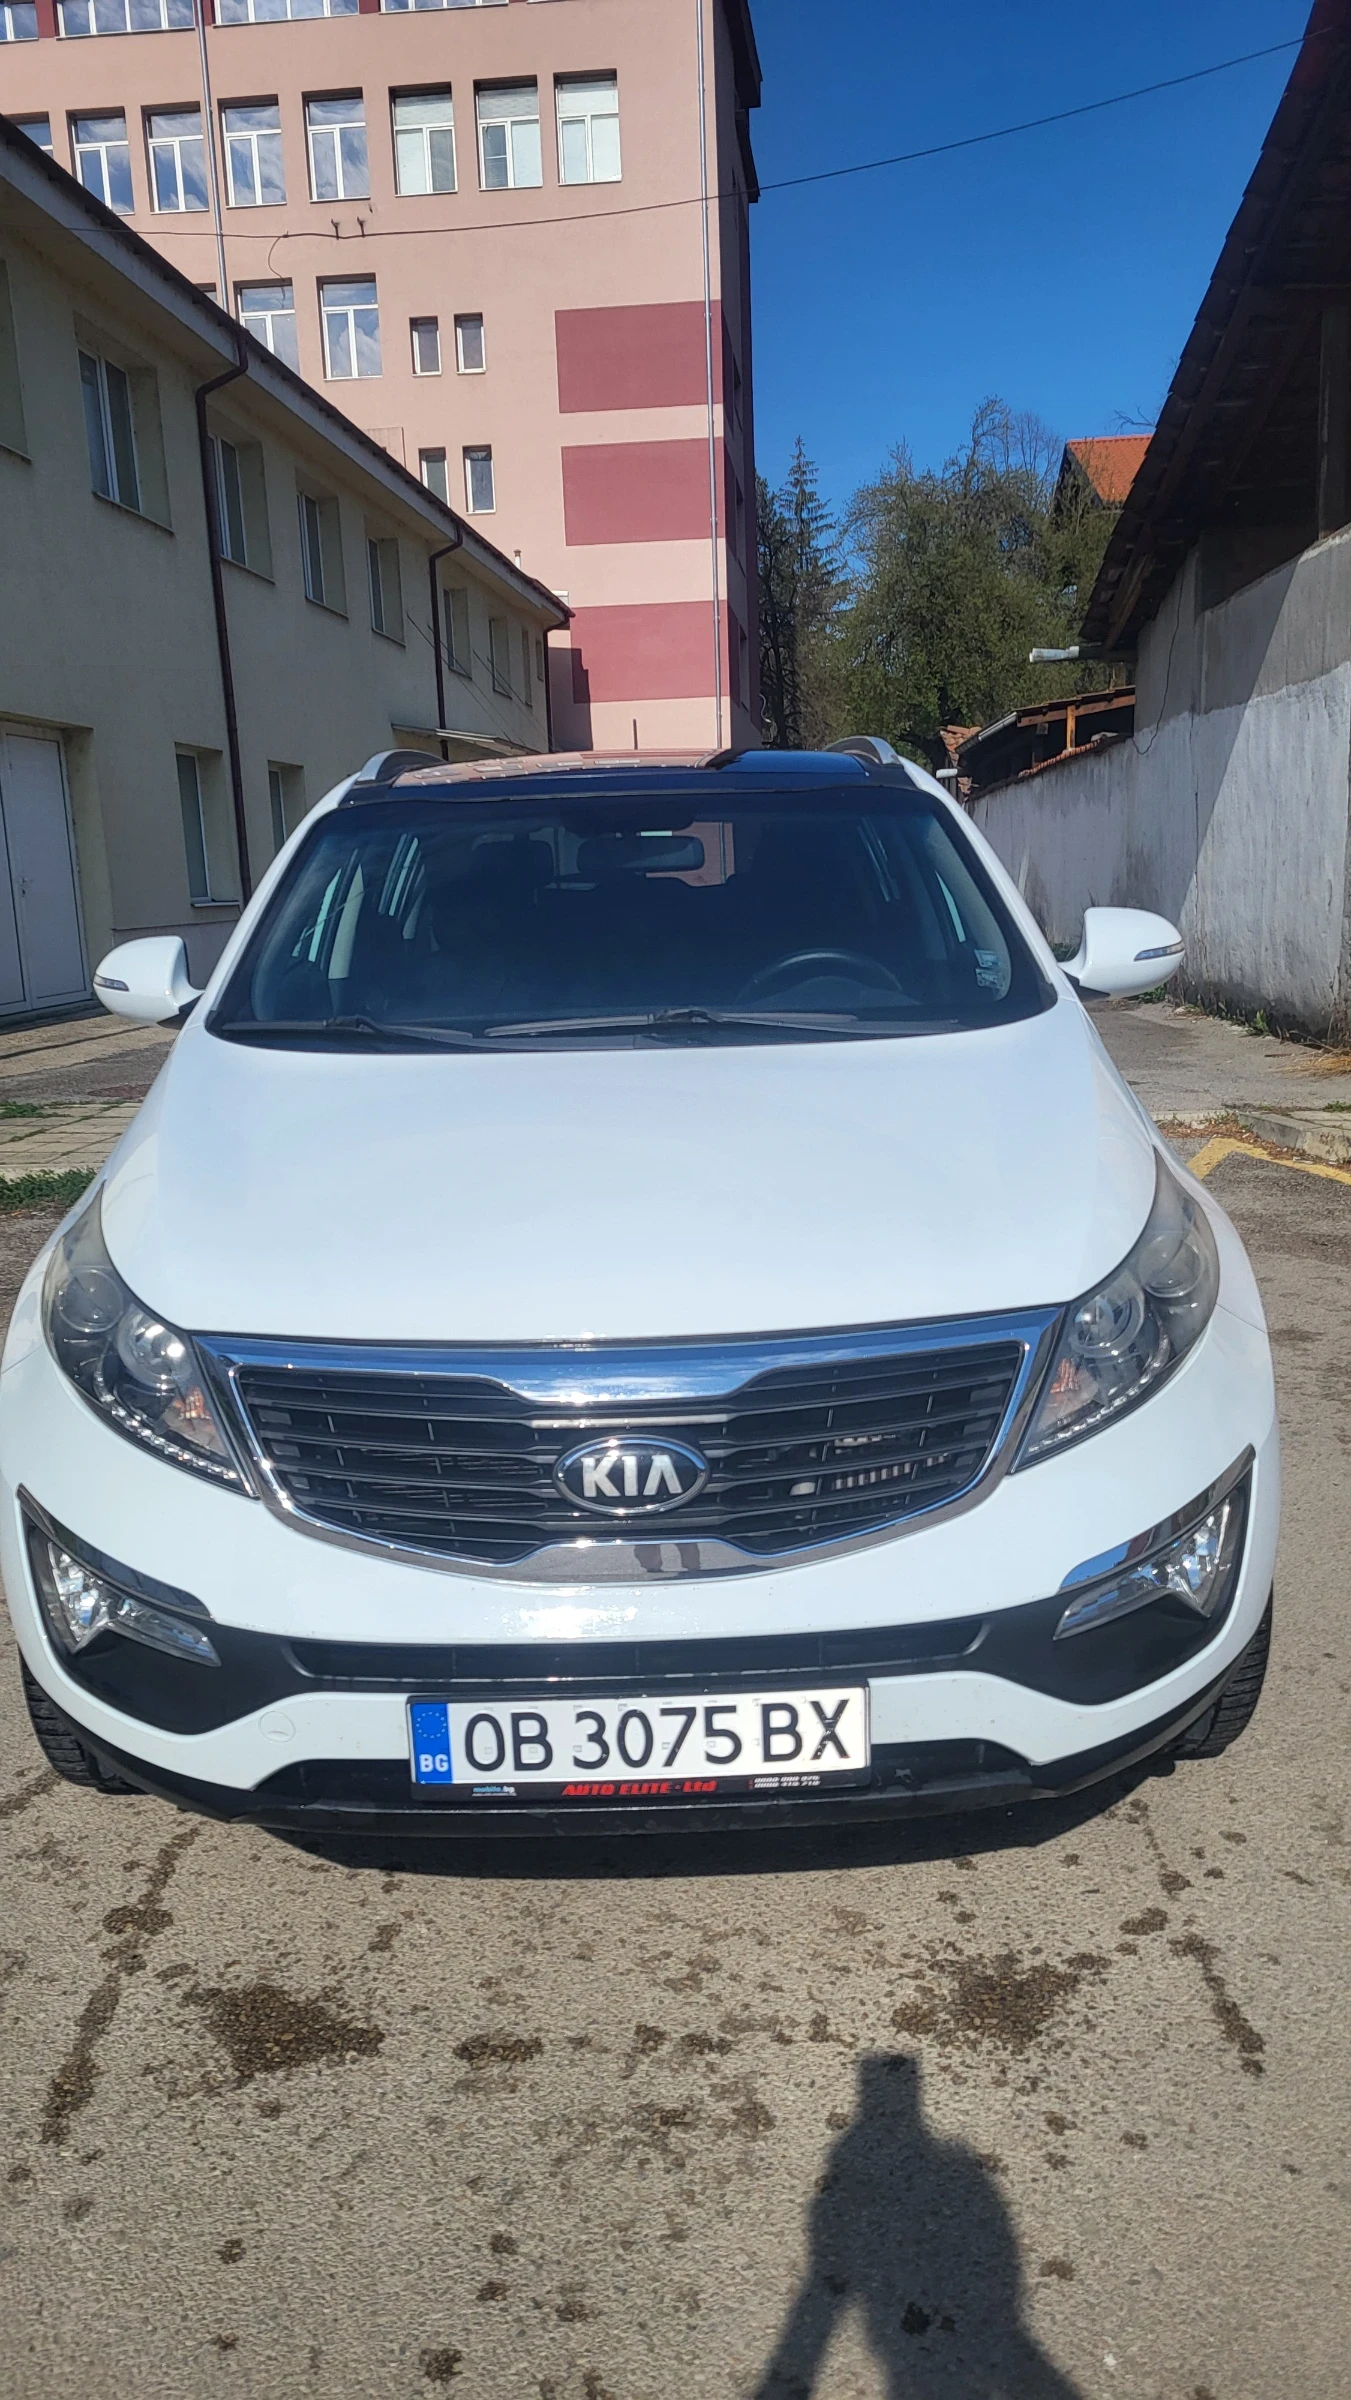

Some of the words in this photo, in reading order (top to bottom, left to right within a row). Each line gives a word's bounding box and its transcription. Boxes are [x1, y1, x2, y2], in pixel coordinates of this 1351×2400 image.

[581, 1454, 684, 1498] KIA
[464, 1712, 554, 1772] OB
[572, 1704, 743, 1770] 3075
[761, 1698, 851, 1763] BX
[418, 1753, 450, 1773] BG
[561, 1783, 615, 1796] AUTO
[618, 1781, 672, 1794] ELITE
[682, 1780, 717, 1793] Ltd
